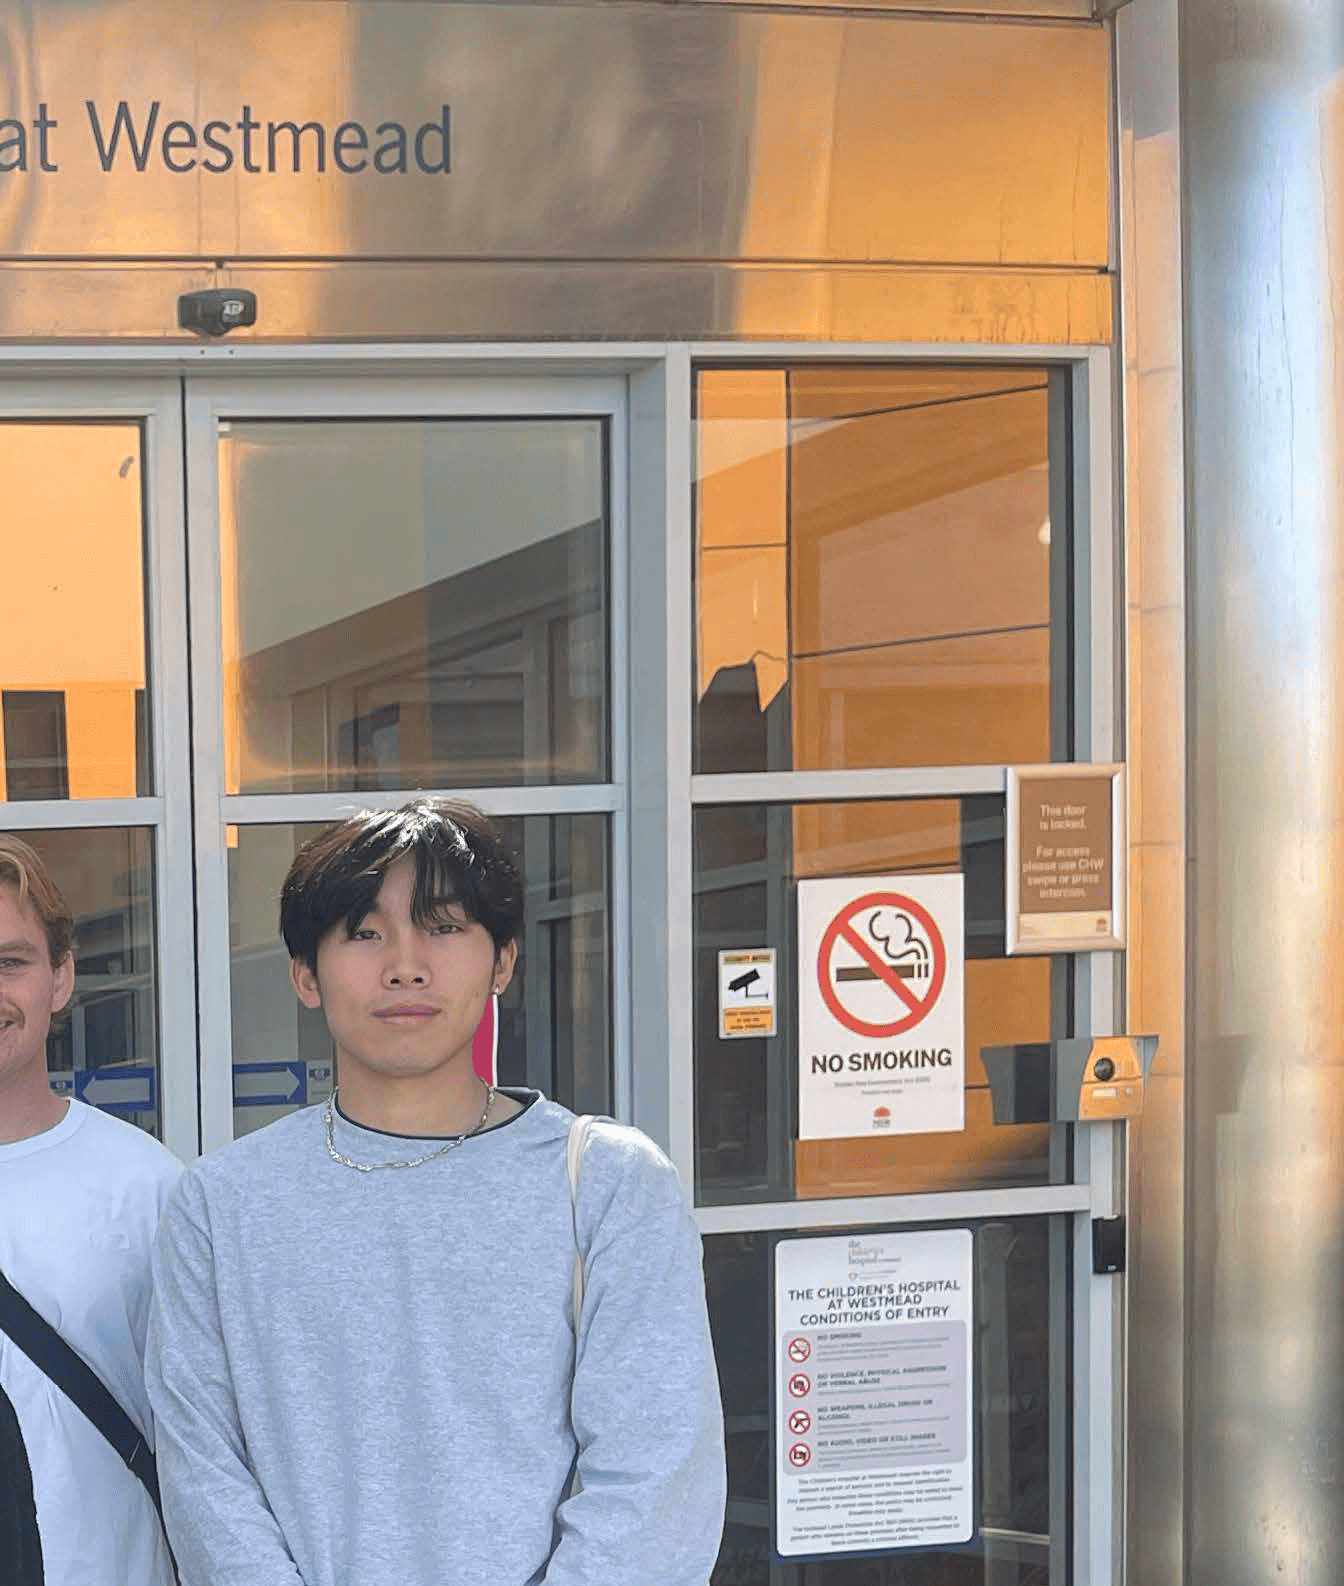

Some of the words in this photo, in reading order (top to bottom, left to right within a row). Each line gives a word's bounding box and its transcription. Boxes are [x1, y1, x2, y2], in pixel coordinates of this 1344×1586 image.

[85, 99, 453, 174] Westmead
[811, 1053, 843, 1074] NO
[847, 1047, 953, 1072] SMOKING
[788, 1289, 813, 1301] THE
[817, 1283, 895, 1299] CHILDREN'S
[898, 1279, 961, 1294] HOSPITAL
[827, 1299, 843, 1311] AT
[847, 1294, 923, 1309] WESTMEAD
[800, 1309, 882, 1326] CONDITIONS
[885, 1308, 904, 1321] OF
[907, 1305, 950, 1319] ENTRY
